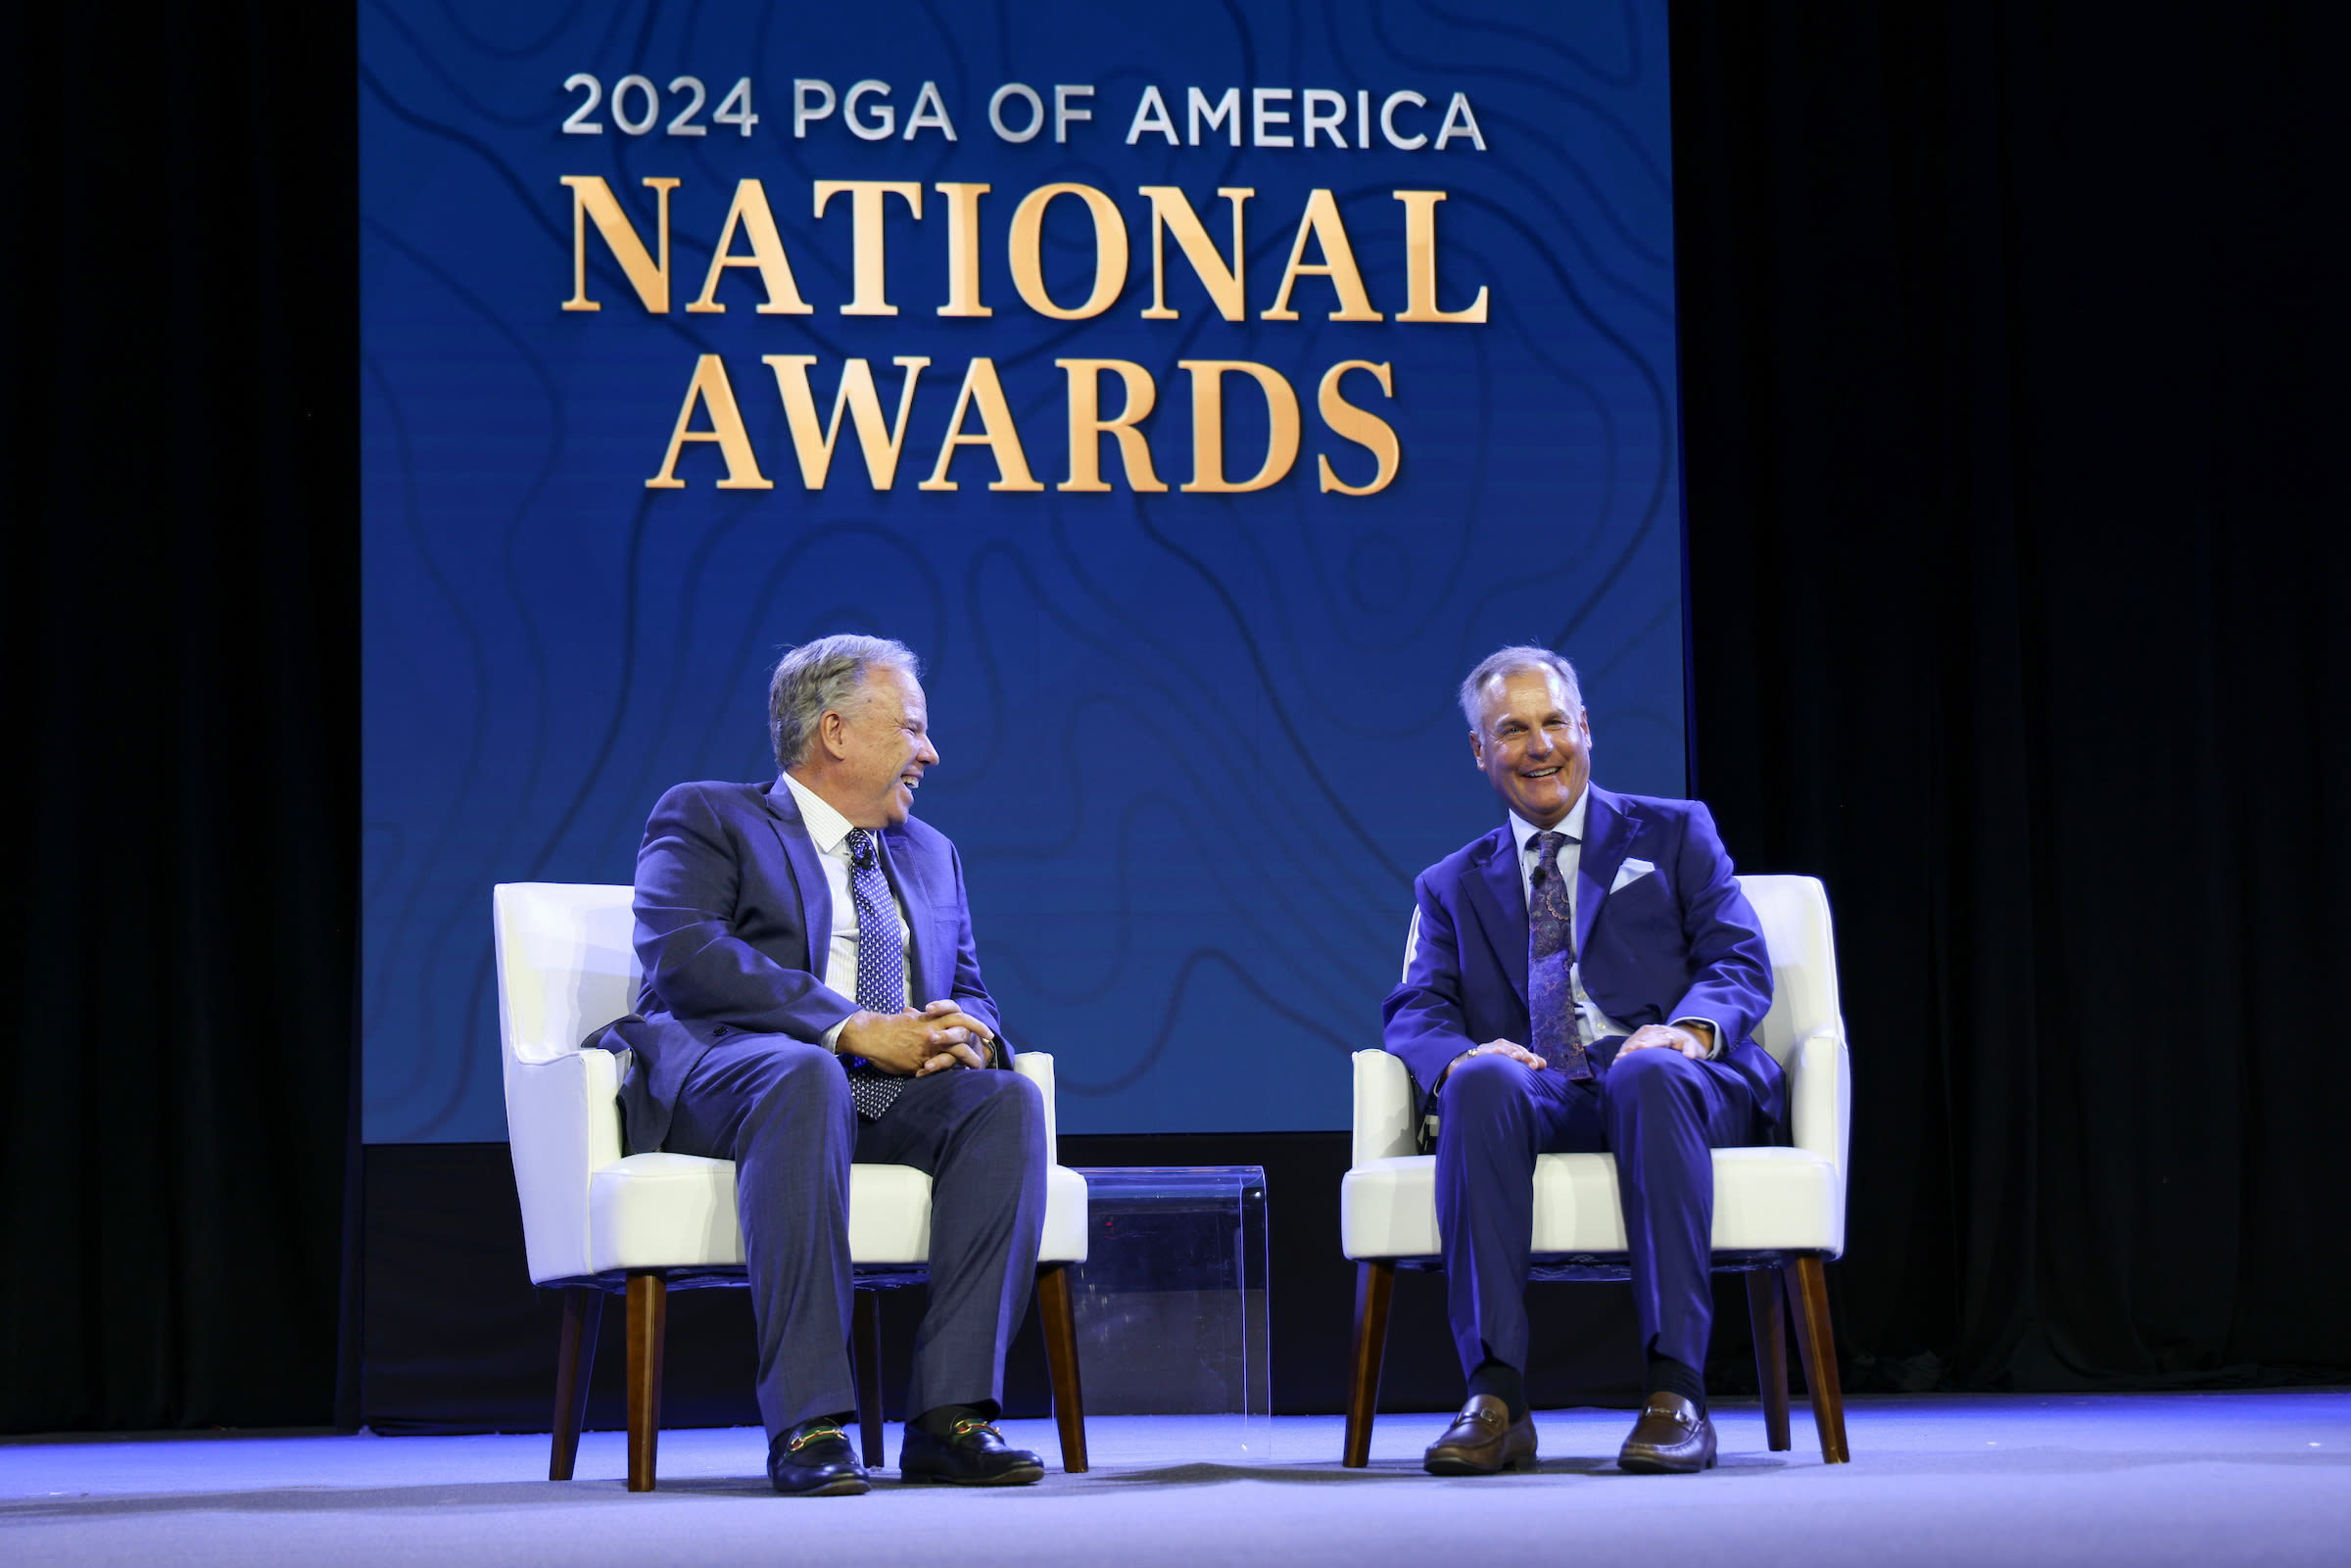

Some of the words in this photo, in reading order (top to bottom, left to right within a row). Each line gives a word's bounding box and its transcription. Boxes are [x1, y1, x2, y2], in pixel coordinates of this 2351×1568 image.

[561, 73, 759, 137] 2024
[792, 79, 958, 142] PGA
[987, 82, 1095, 145] OF
[1125, 84, 1487, 151] AMERICA
[559, 175, 1489, 324] NATIONAL
[645, 354, 1401, 497] AWARDS
